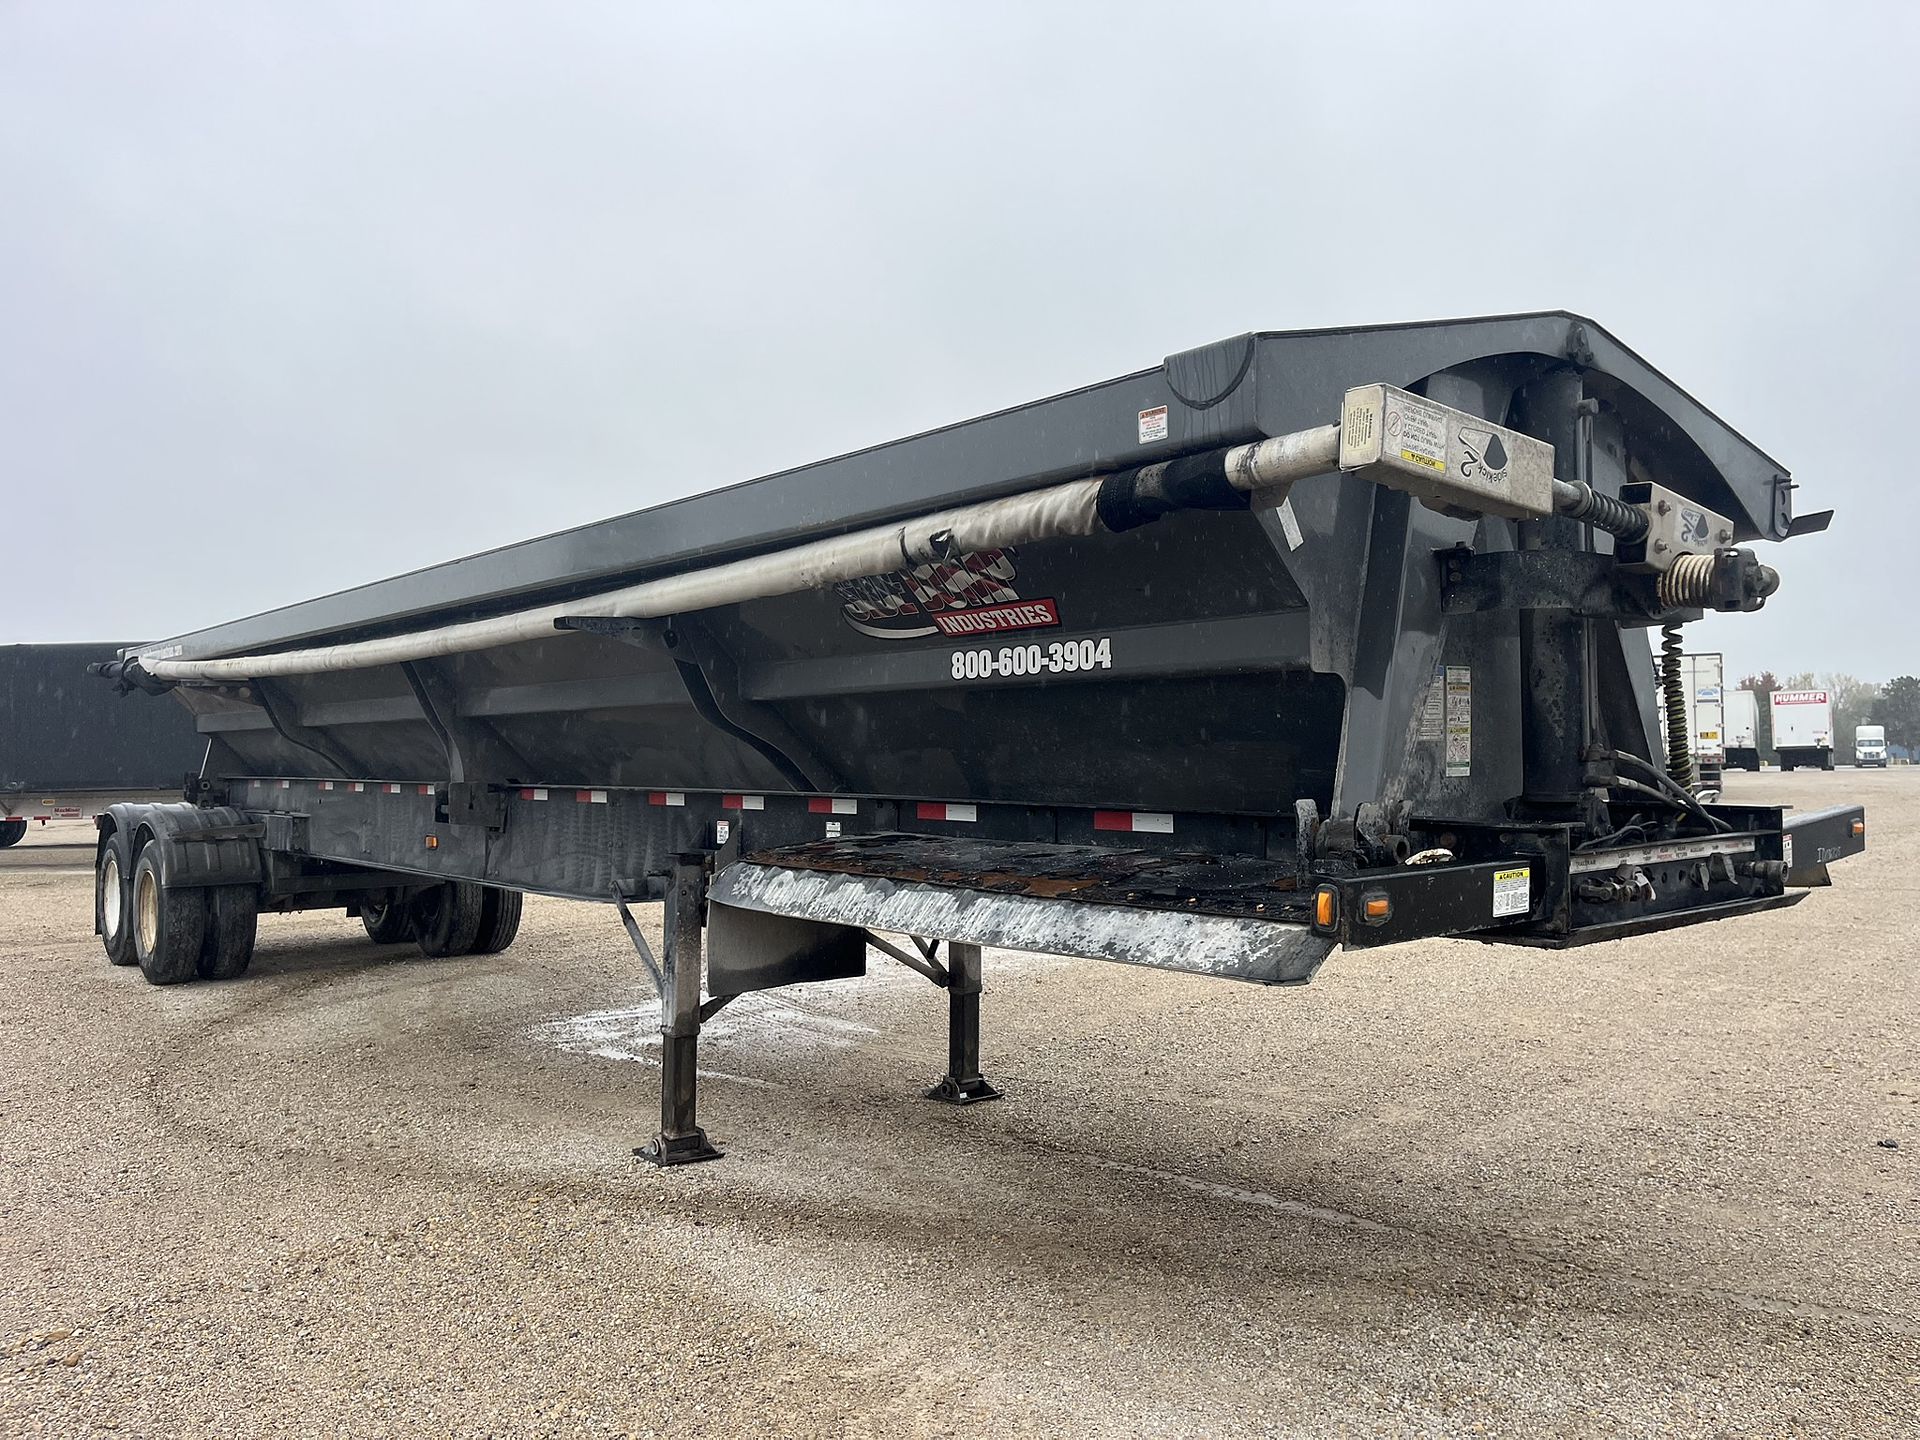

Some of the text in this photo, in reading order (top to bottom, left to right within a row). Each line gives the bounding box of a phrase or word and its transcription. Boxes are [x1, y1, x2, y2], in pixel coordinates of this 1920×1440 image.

[936, 603, 1053, 635] INDUSTRIES
[951, 638, 1112, 680] 800-600-3904
[1775, 692, 1826, 703] HUMMER
[1503, 872, 1523, 880] CAUTION
